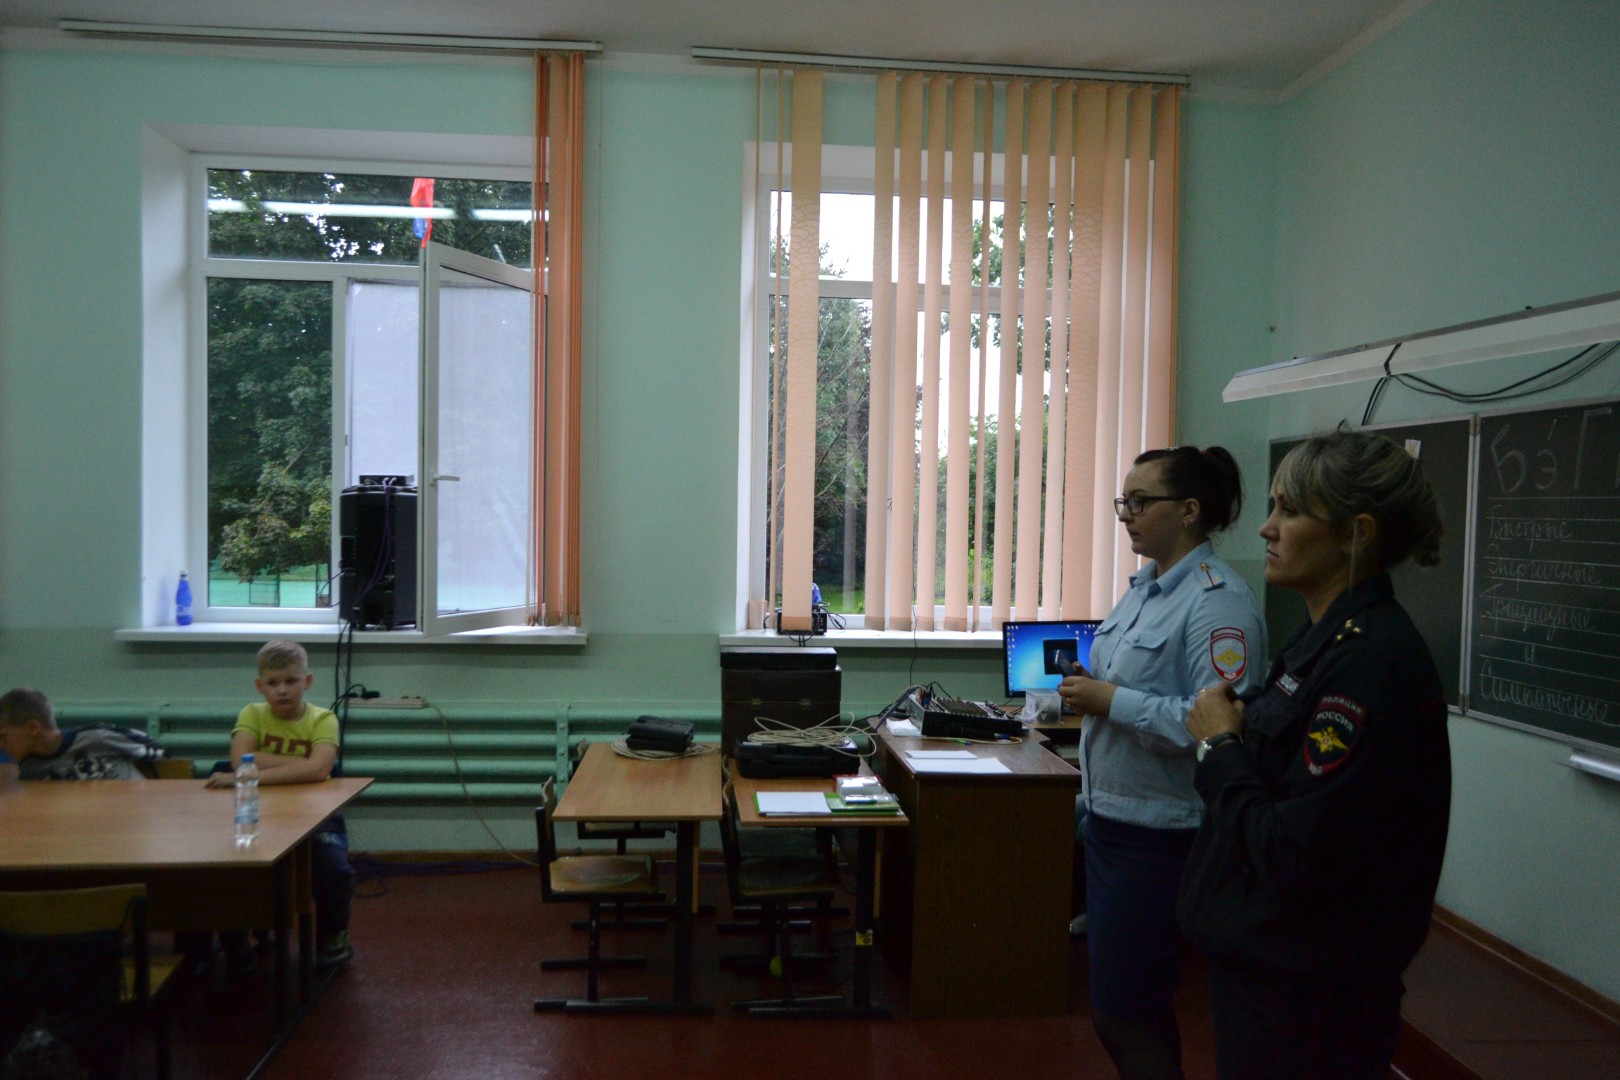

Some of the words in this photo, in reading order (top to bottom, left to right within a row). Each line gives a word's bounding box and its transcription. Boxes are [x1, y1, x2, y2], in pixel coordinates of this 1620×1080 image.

[1487, 505, 1573, 553] Быстрые
[1485, 543, 1602, 591] Энергичные
[1315, 711, 1354, 734] РОССИЯ
[1321, 695, 1362, 717] ПОЛИЦИЯ
